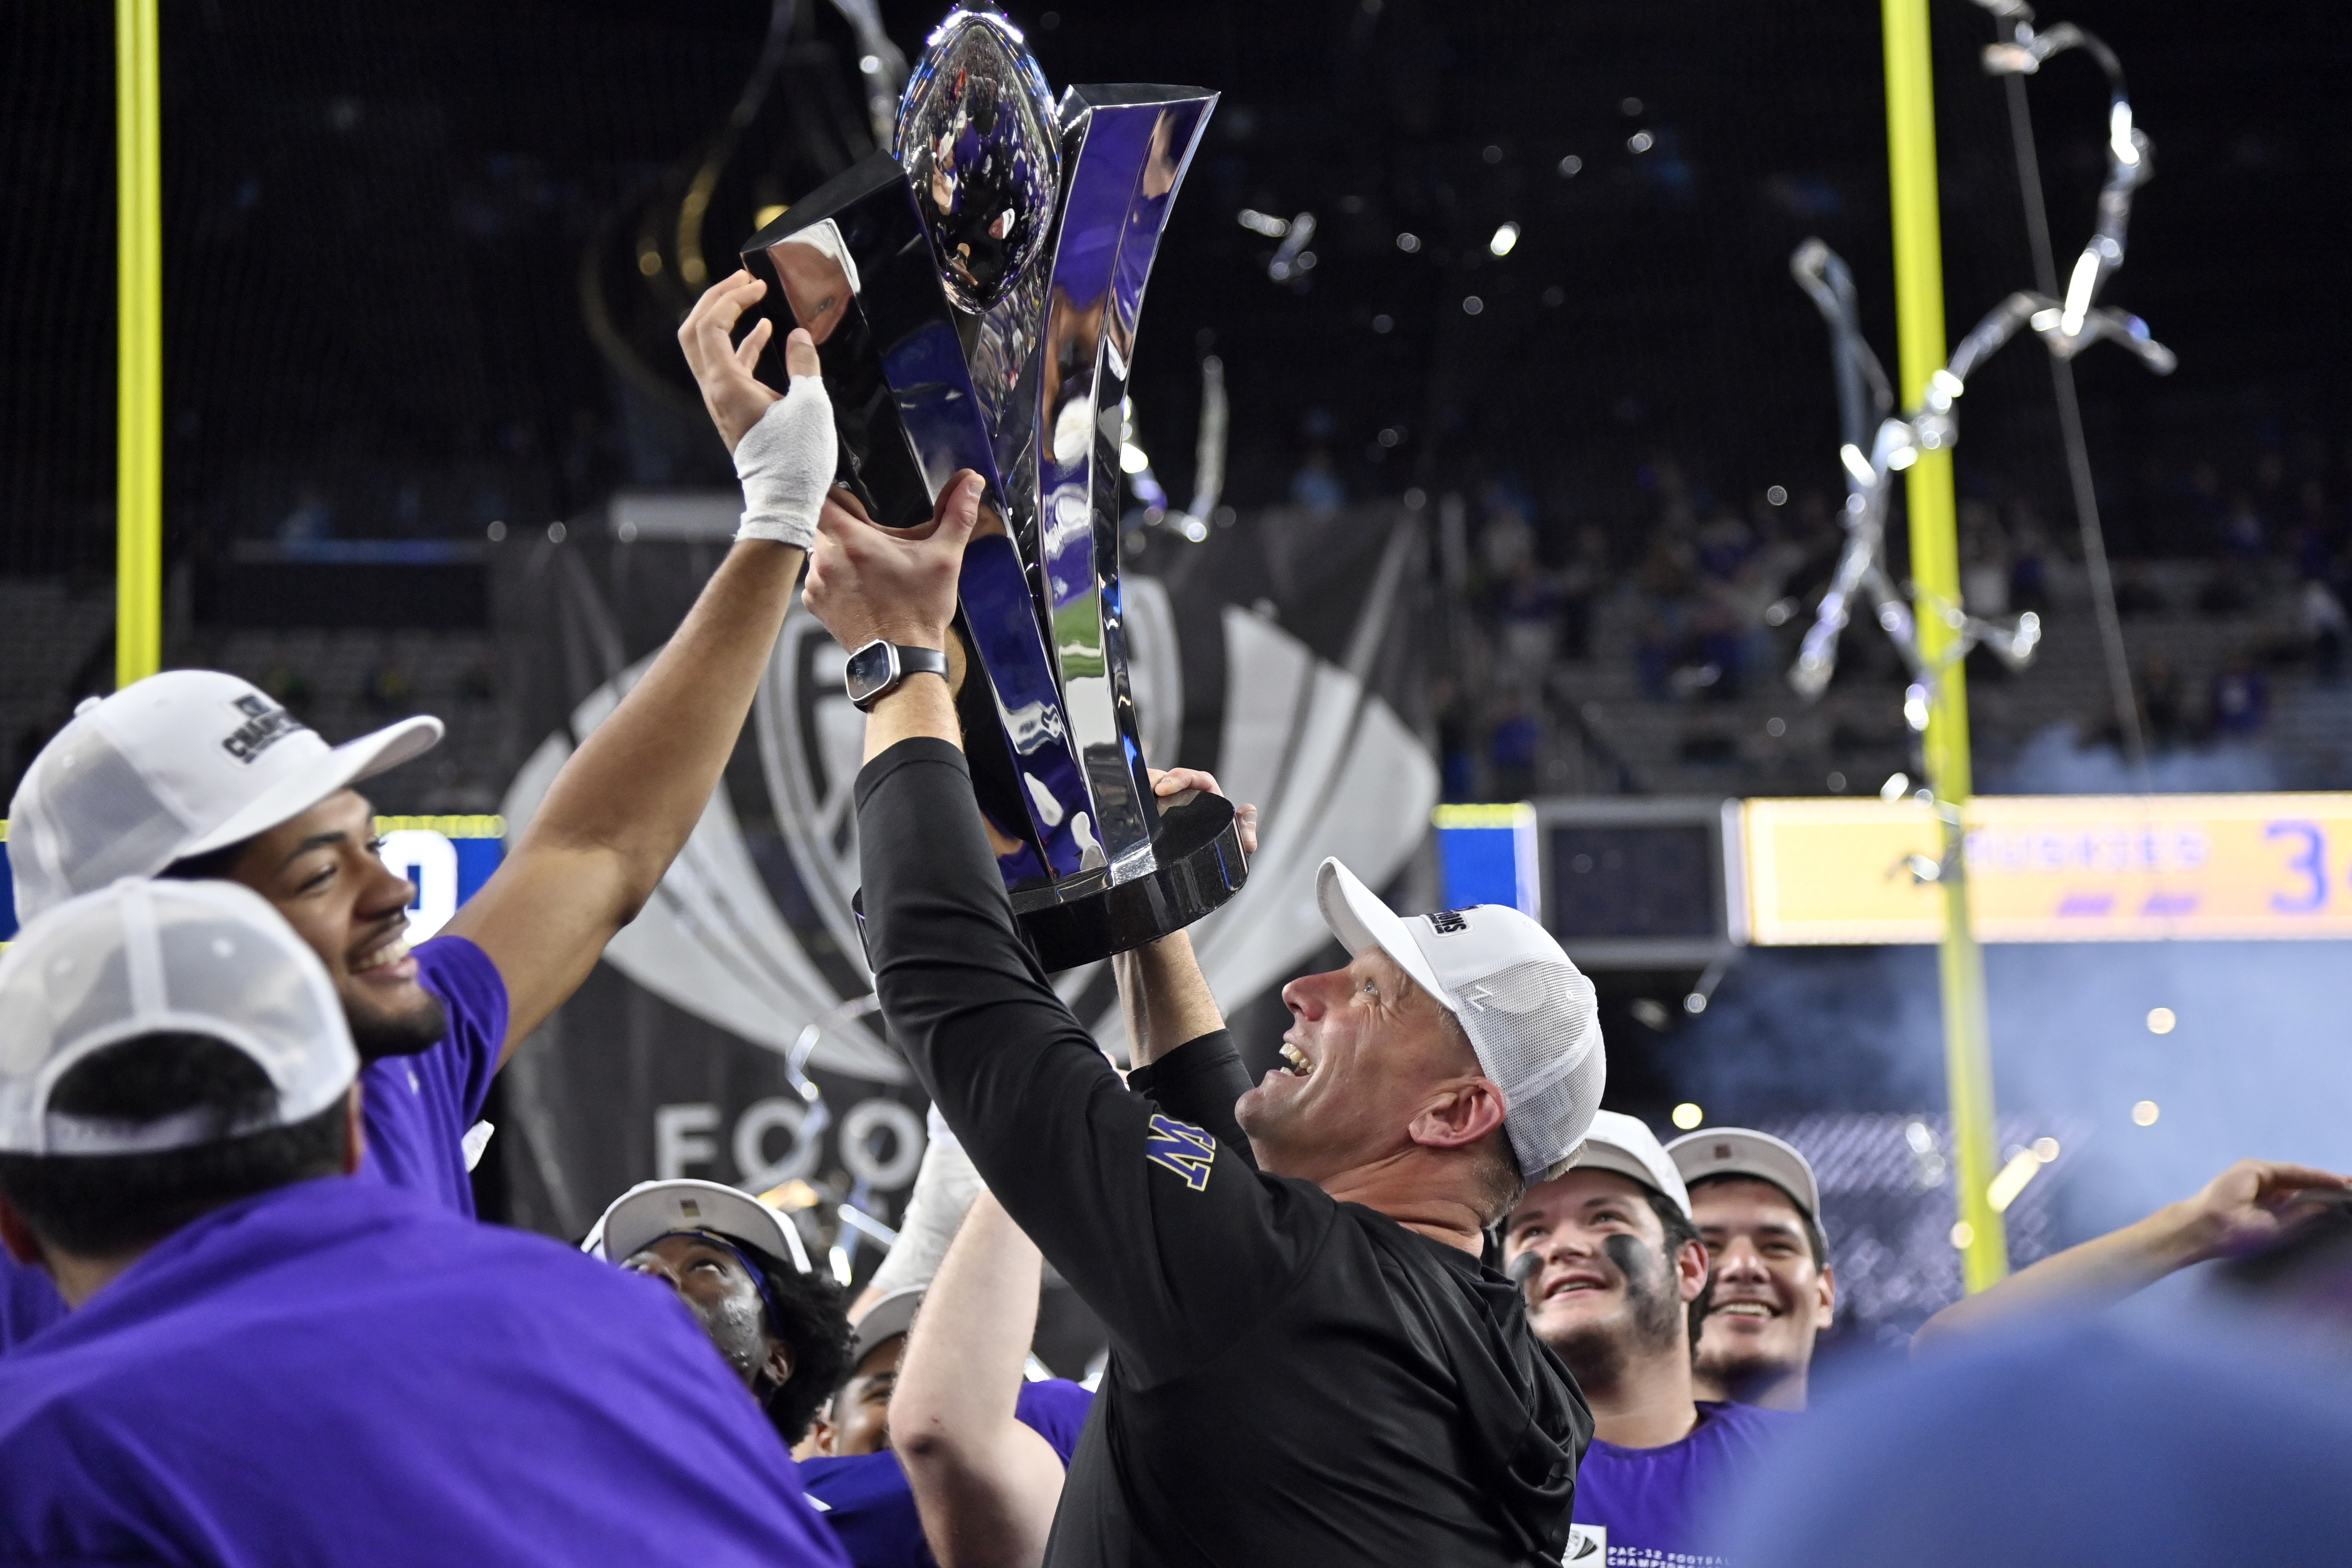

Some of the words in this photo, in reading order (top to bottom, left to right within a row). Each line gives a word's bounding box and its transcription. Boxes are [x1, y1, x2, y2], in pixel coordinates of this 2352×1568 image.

[2266, 818, 2352, 914] 3
[1146, 1114, 1216, 1192] W
[1607, 1546, 1663, 1560] PAC-12
[1667, 1552, 1731, 1566] FOOTBAL
